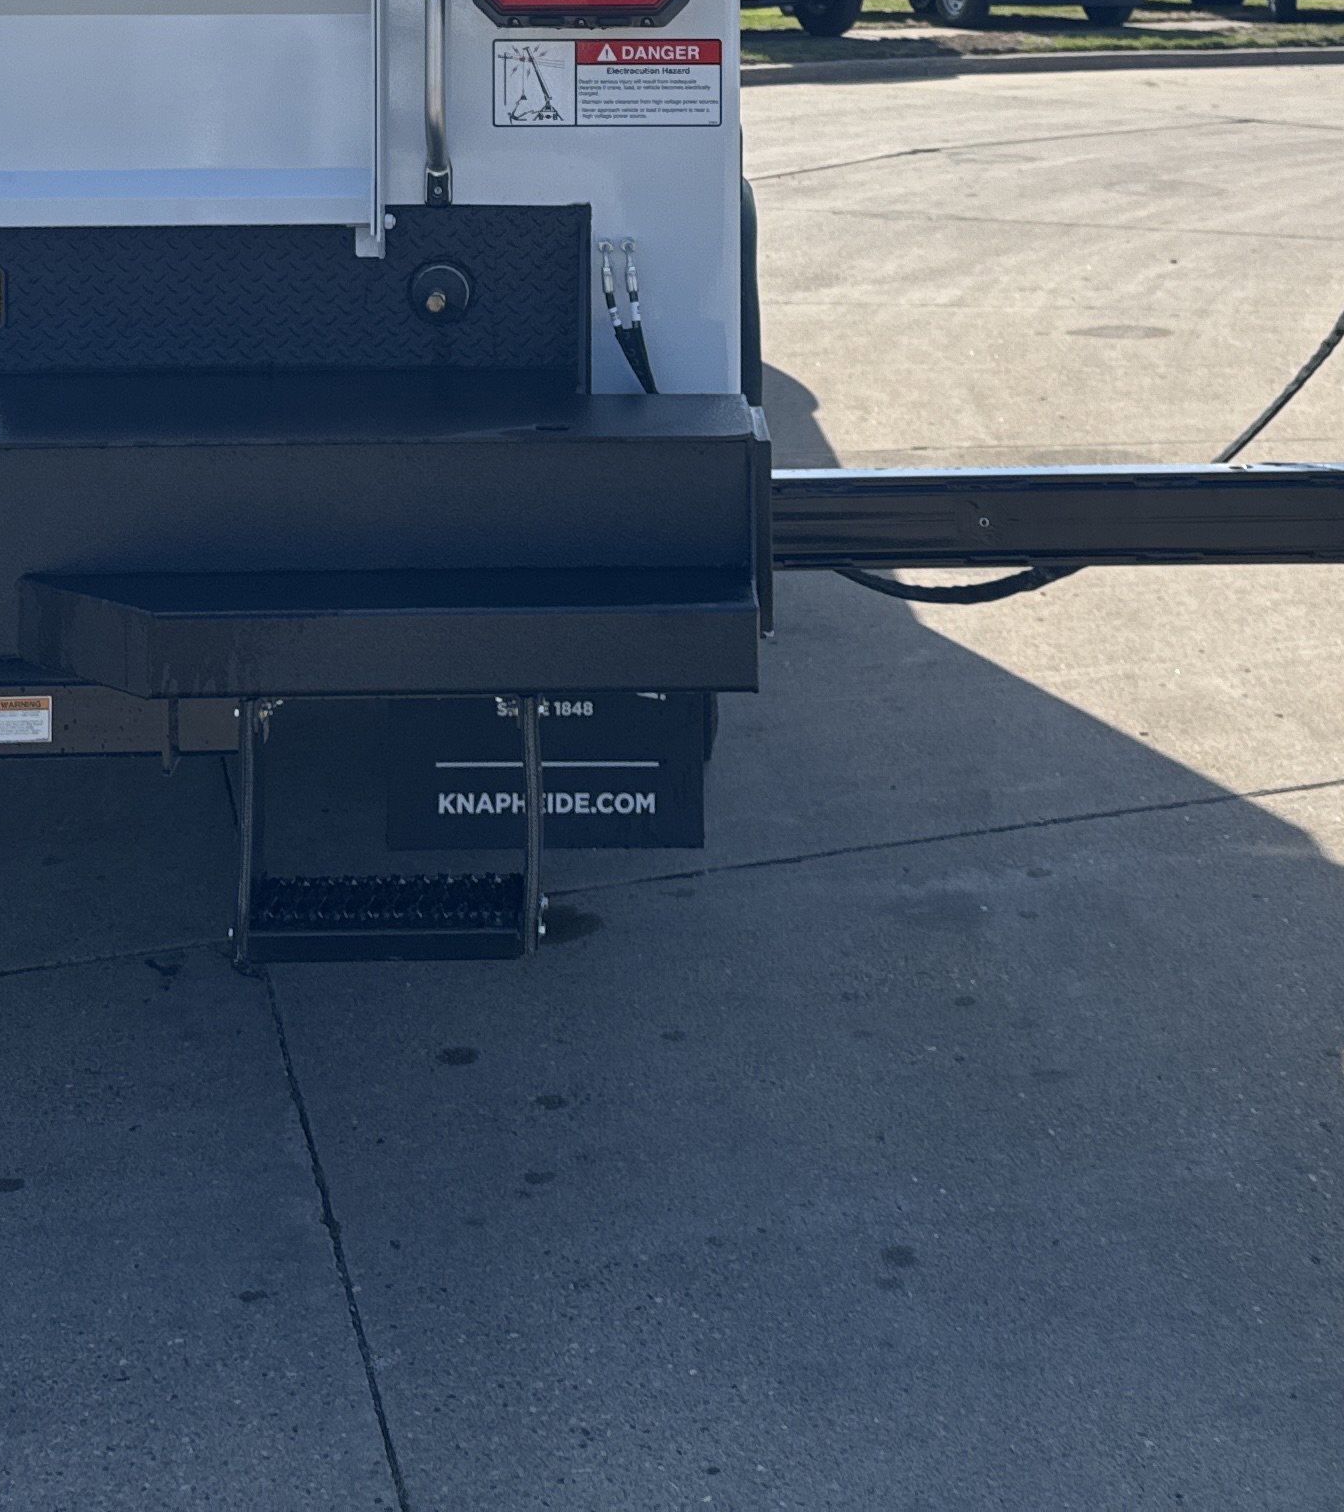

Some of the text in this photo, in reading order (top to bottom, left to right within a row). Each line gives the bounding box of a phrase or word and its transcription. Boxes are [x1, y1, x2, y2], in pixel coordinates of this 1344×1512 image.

[621, 46, 700, 60] DANGER
[662, 67, 690, 75] Hazard
[555, 701, 594, 716] 1848
[438, 792, 656, 815] KNAPHIDE.COM
